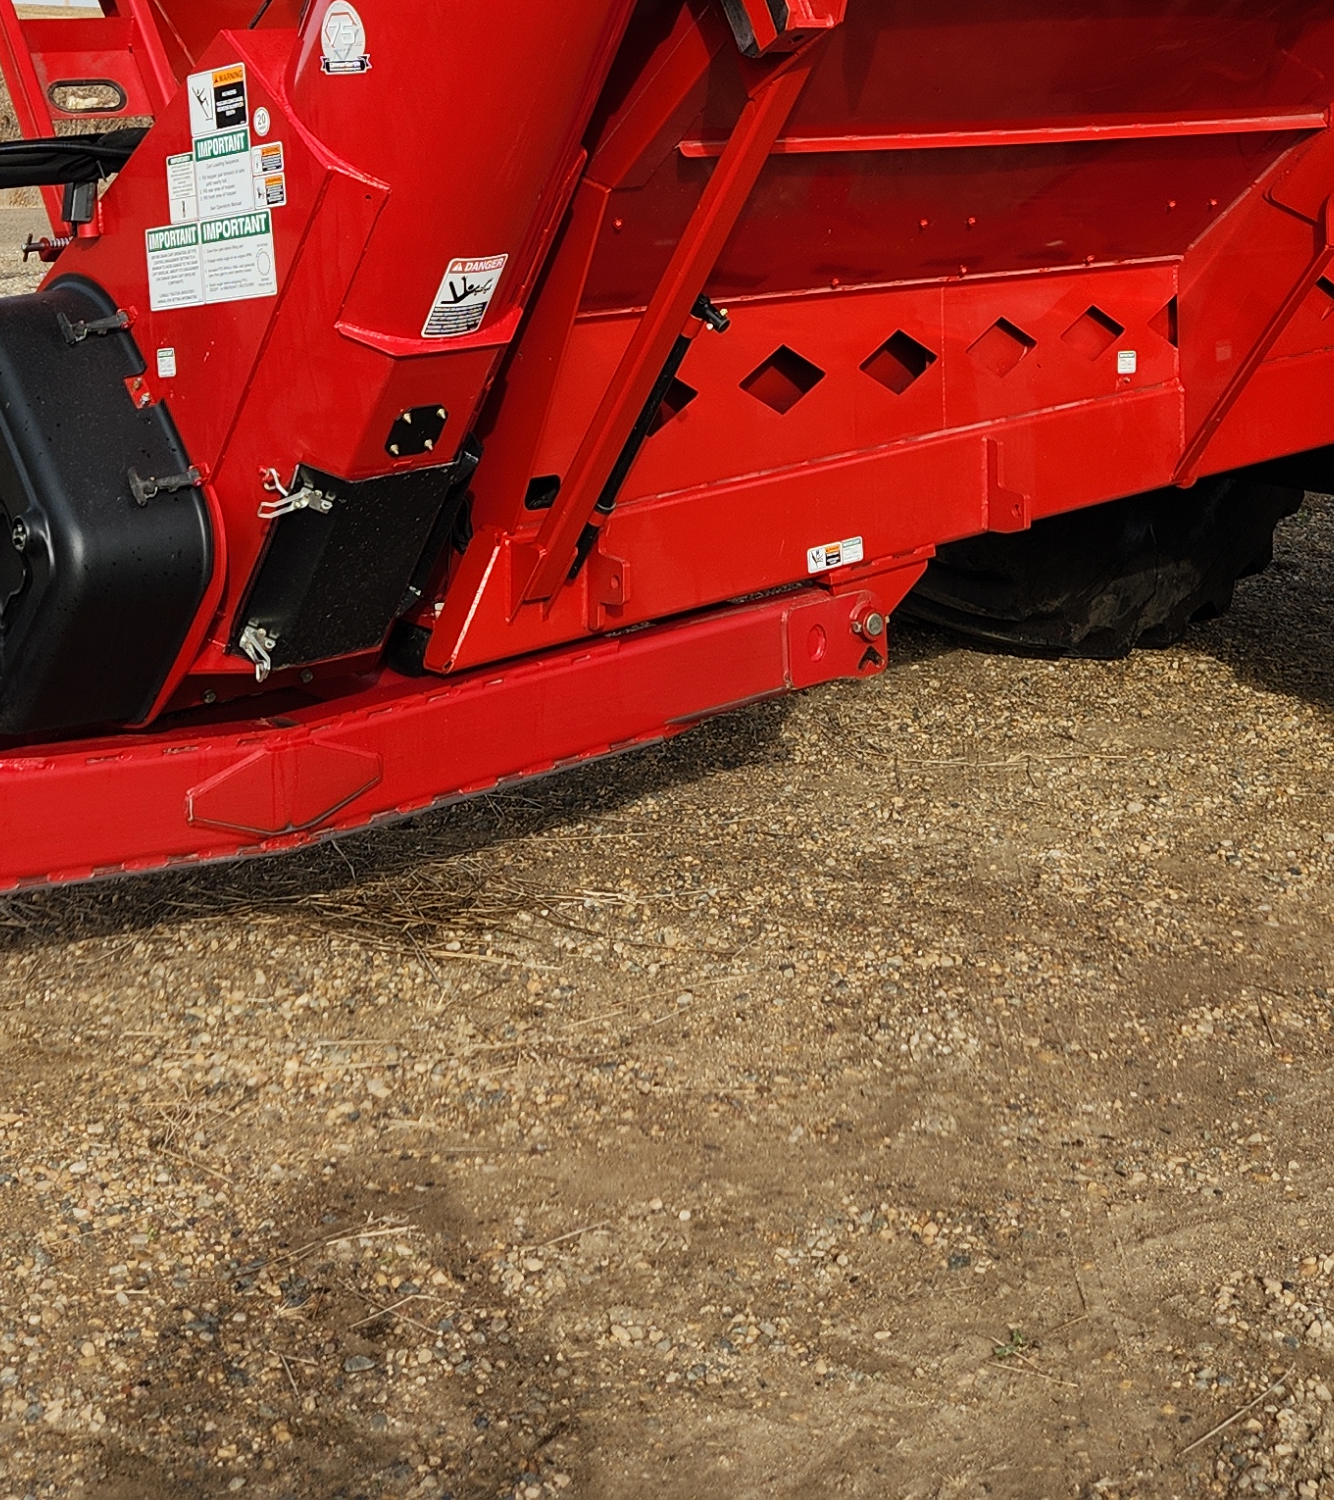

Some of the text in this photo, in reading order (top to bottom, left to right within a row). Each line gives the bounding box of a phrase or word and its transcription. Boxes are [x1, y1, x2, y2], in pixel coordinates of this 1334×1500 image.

[219, 69, 243, 82] WARNING
[257, 113, 266, 125] 20
[197, 132, 245, 159] IMPORTANT
[203, 214, 267, 241] IMPORTANT
[149, 227, 197, 250] IMPORTANT
[464, 258, 504, 271] DANGER
